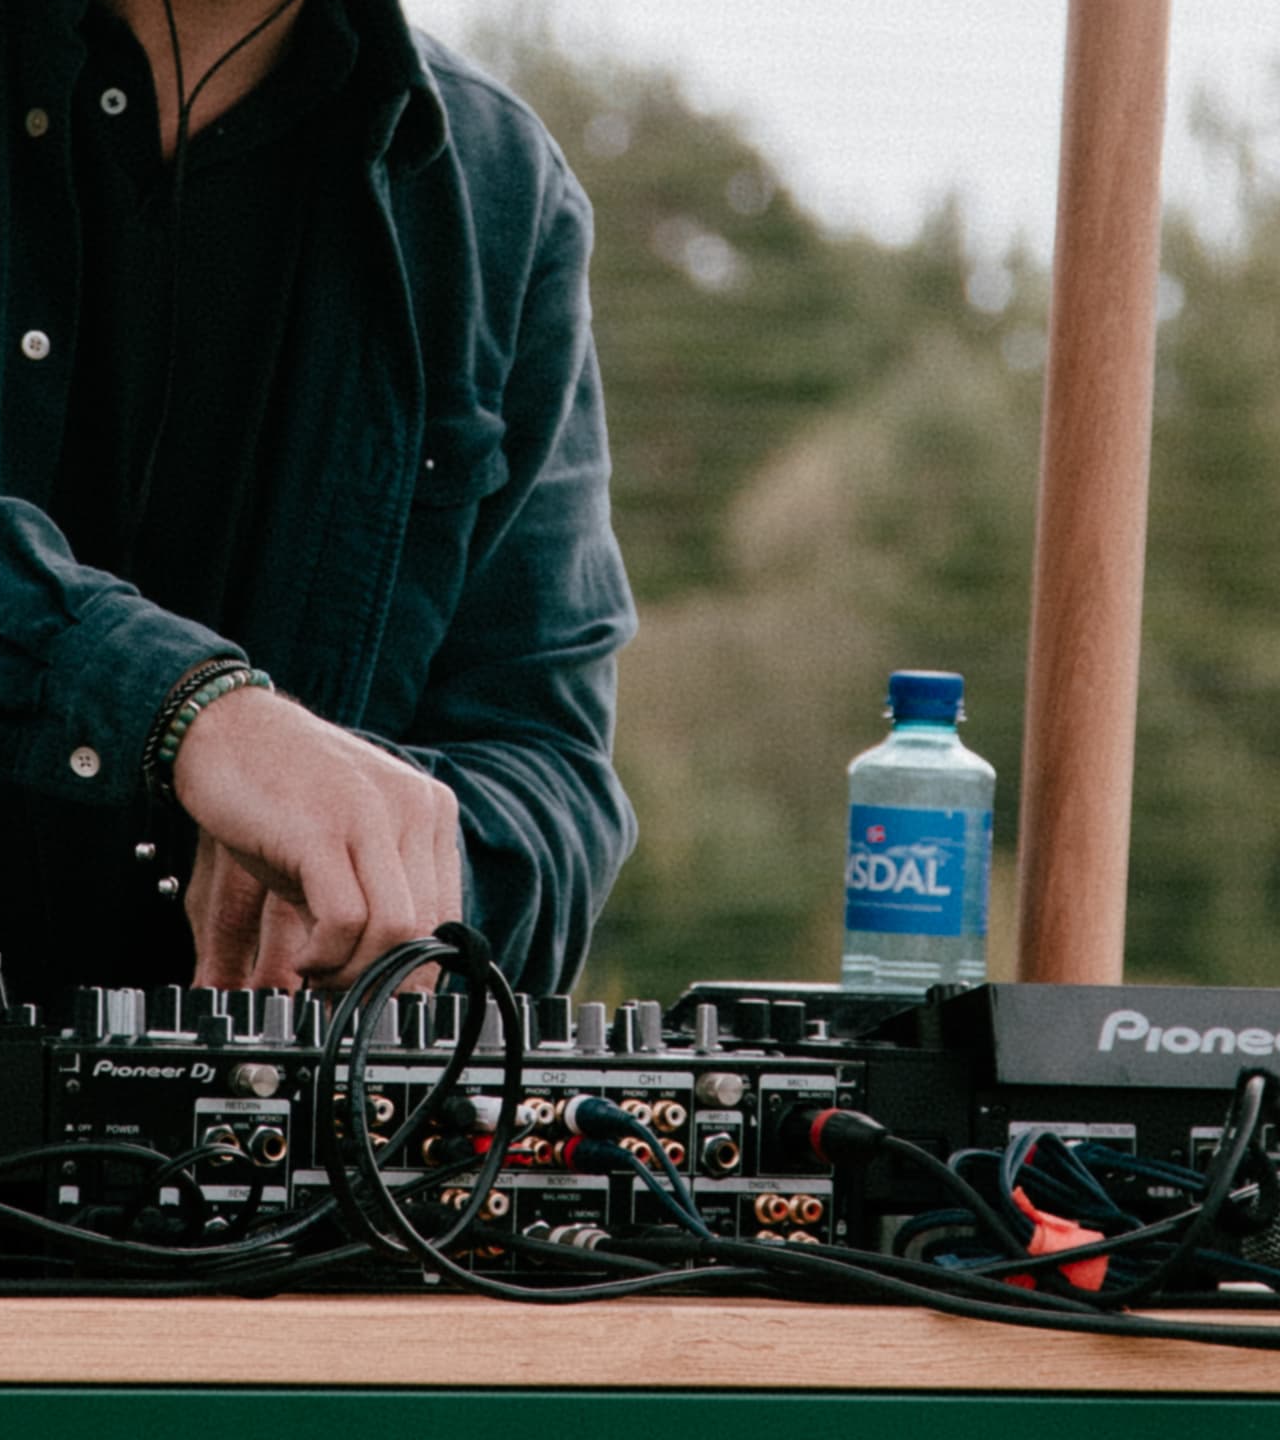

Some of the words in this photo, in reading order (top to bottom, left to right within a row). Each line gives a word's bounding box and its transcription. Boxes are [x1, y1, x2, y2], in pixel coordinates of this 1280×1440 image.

[845, 853, 952, 897] SDAL
[93, 1060, 186, 1078] Pioneer
[105, 1124, 140, 1134] POWER
